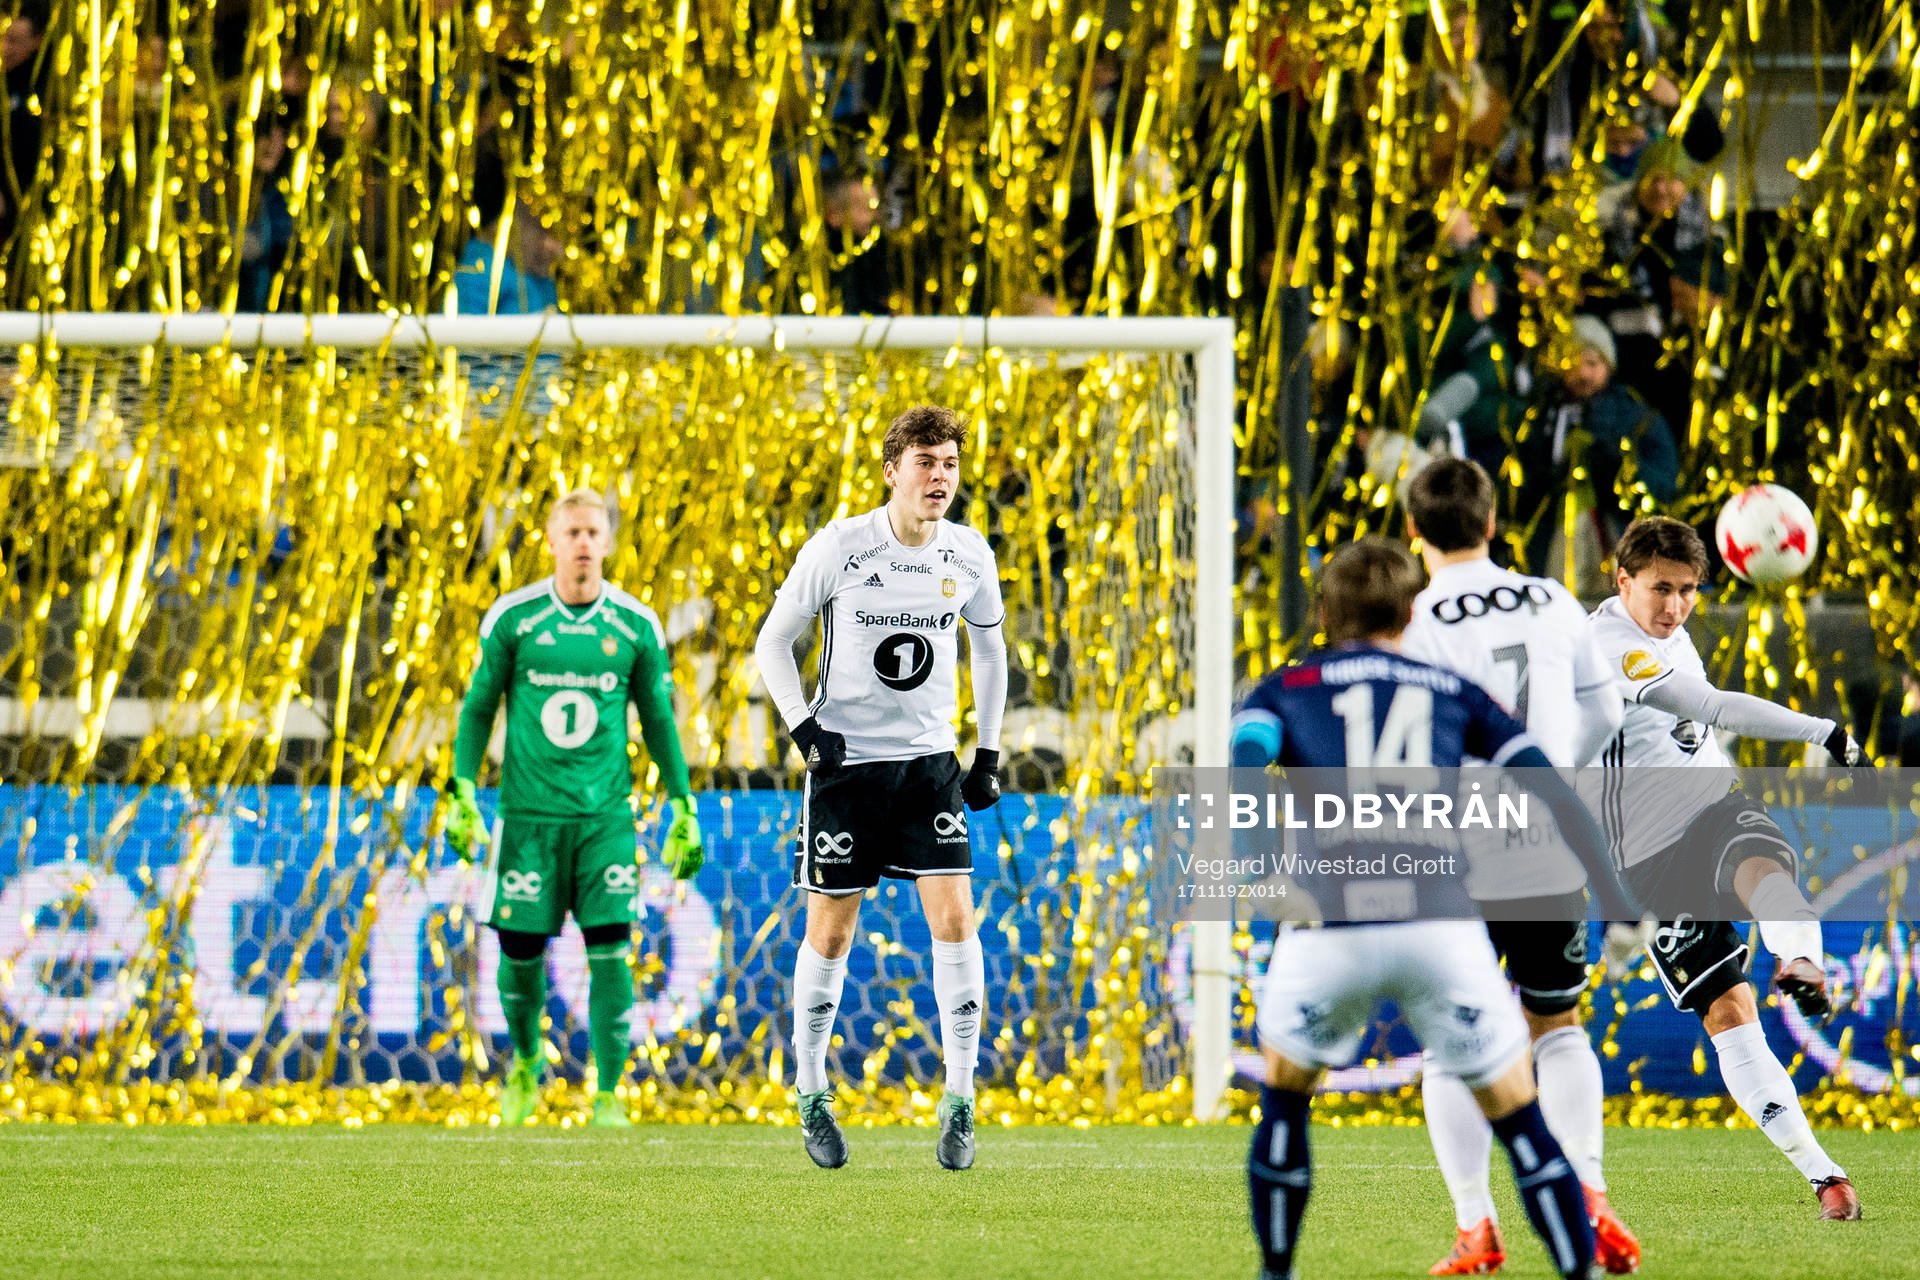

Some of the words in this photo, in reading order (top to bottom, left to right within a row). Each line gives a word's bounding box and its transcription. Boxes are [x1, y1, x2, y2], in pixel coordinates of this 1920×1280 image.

[856, 540, 890, 564] telenor
[890, 561, 933, 575] Scandic
[950, 554, 980, 581] telenor
[855, 610, 938, 628] SpareBank
[1431, 584, 1553, 625] coop
[893, 642, 915, 679] 1
[1491, 643, 1530, 728] 7
[561, 702, 577, 735] 1
[1331, 681, 1440, 806] 14
